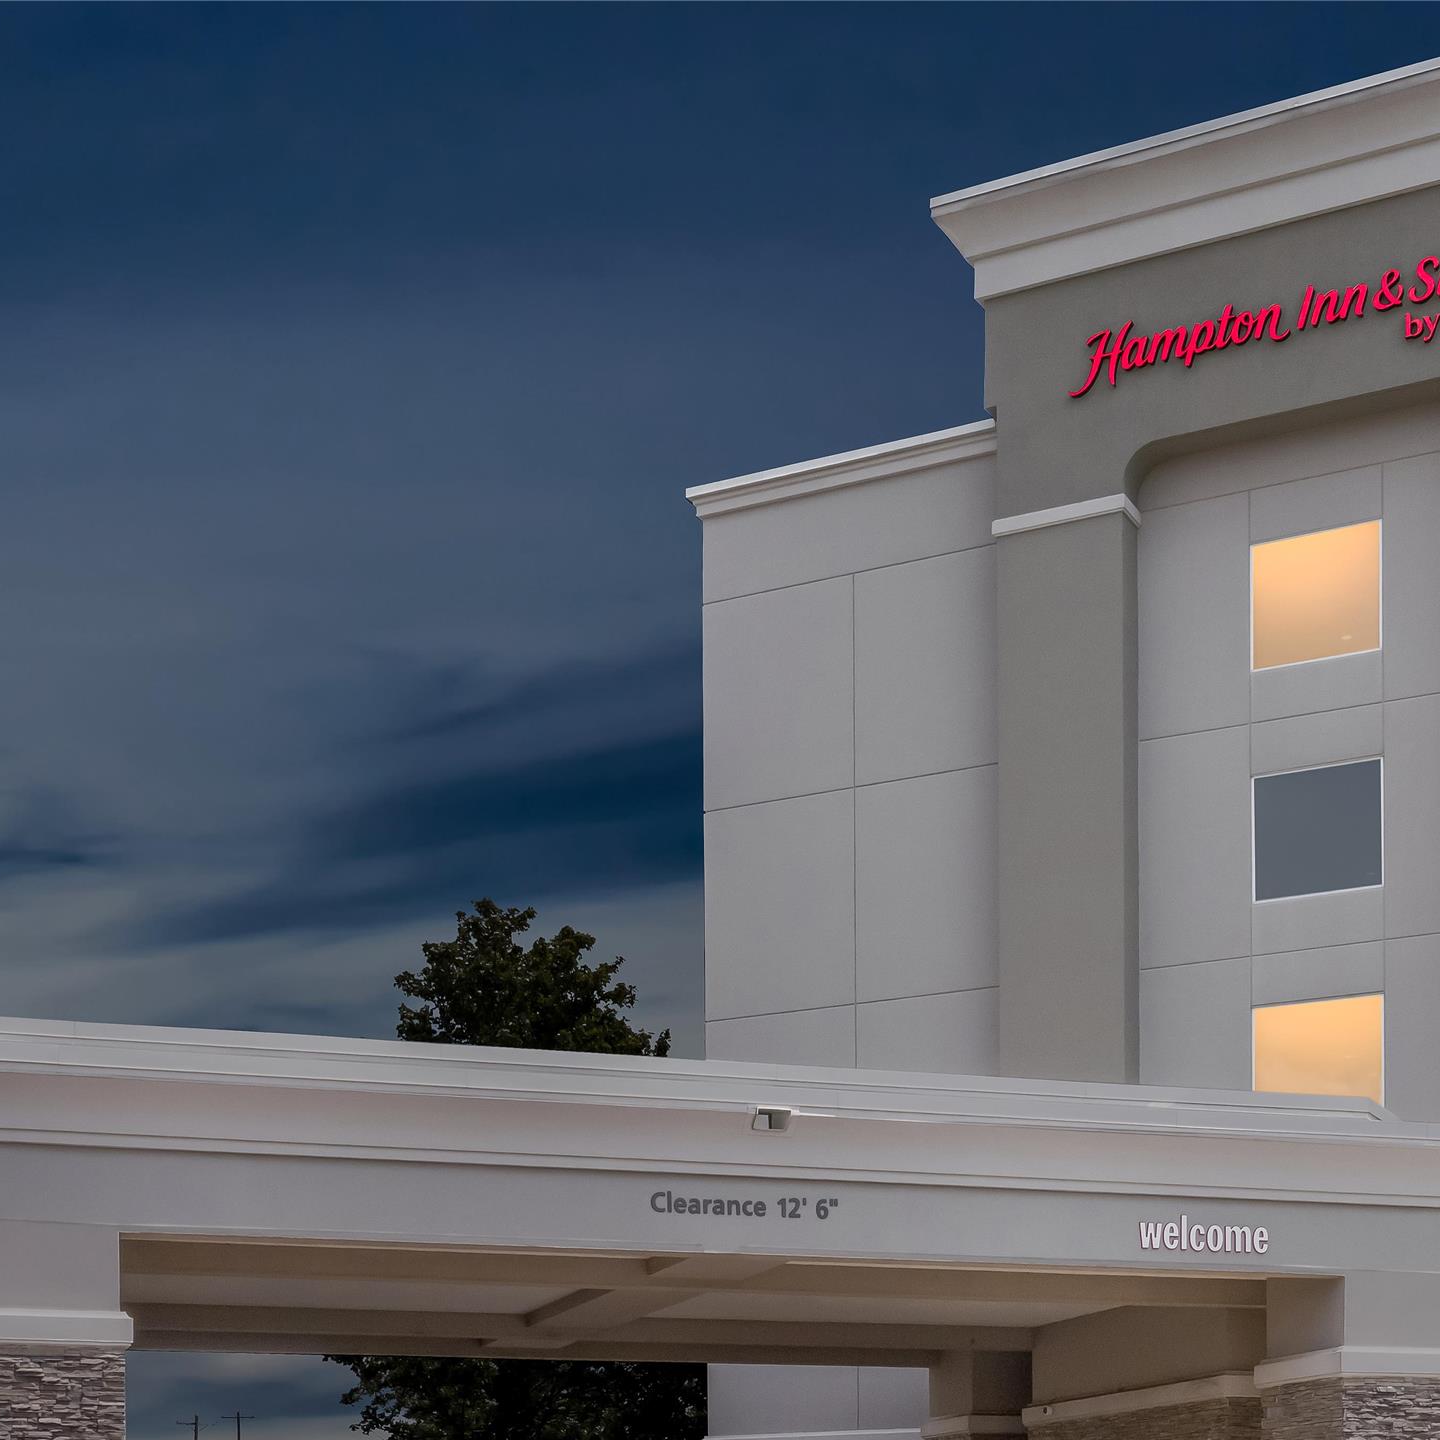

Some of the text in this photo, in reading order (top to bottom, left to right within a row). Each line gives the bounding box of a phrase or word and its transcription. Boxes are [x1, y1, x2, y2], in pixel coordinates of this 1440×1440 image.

[1068, 304, 1290, 398] Hampton
[1297, 283, 1368, 330] Inn
[1372, 269, 1405, 311] &
[1405, 312, 1440, 342] by
[650, 1190, 839, 1220] Clearance 12' 6"
[1139, 1214, 1270, 1254] welcome
